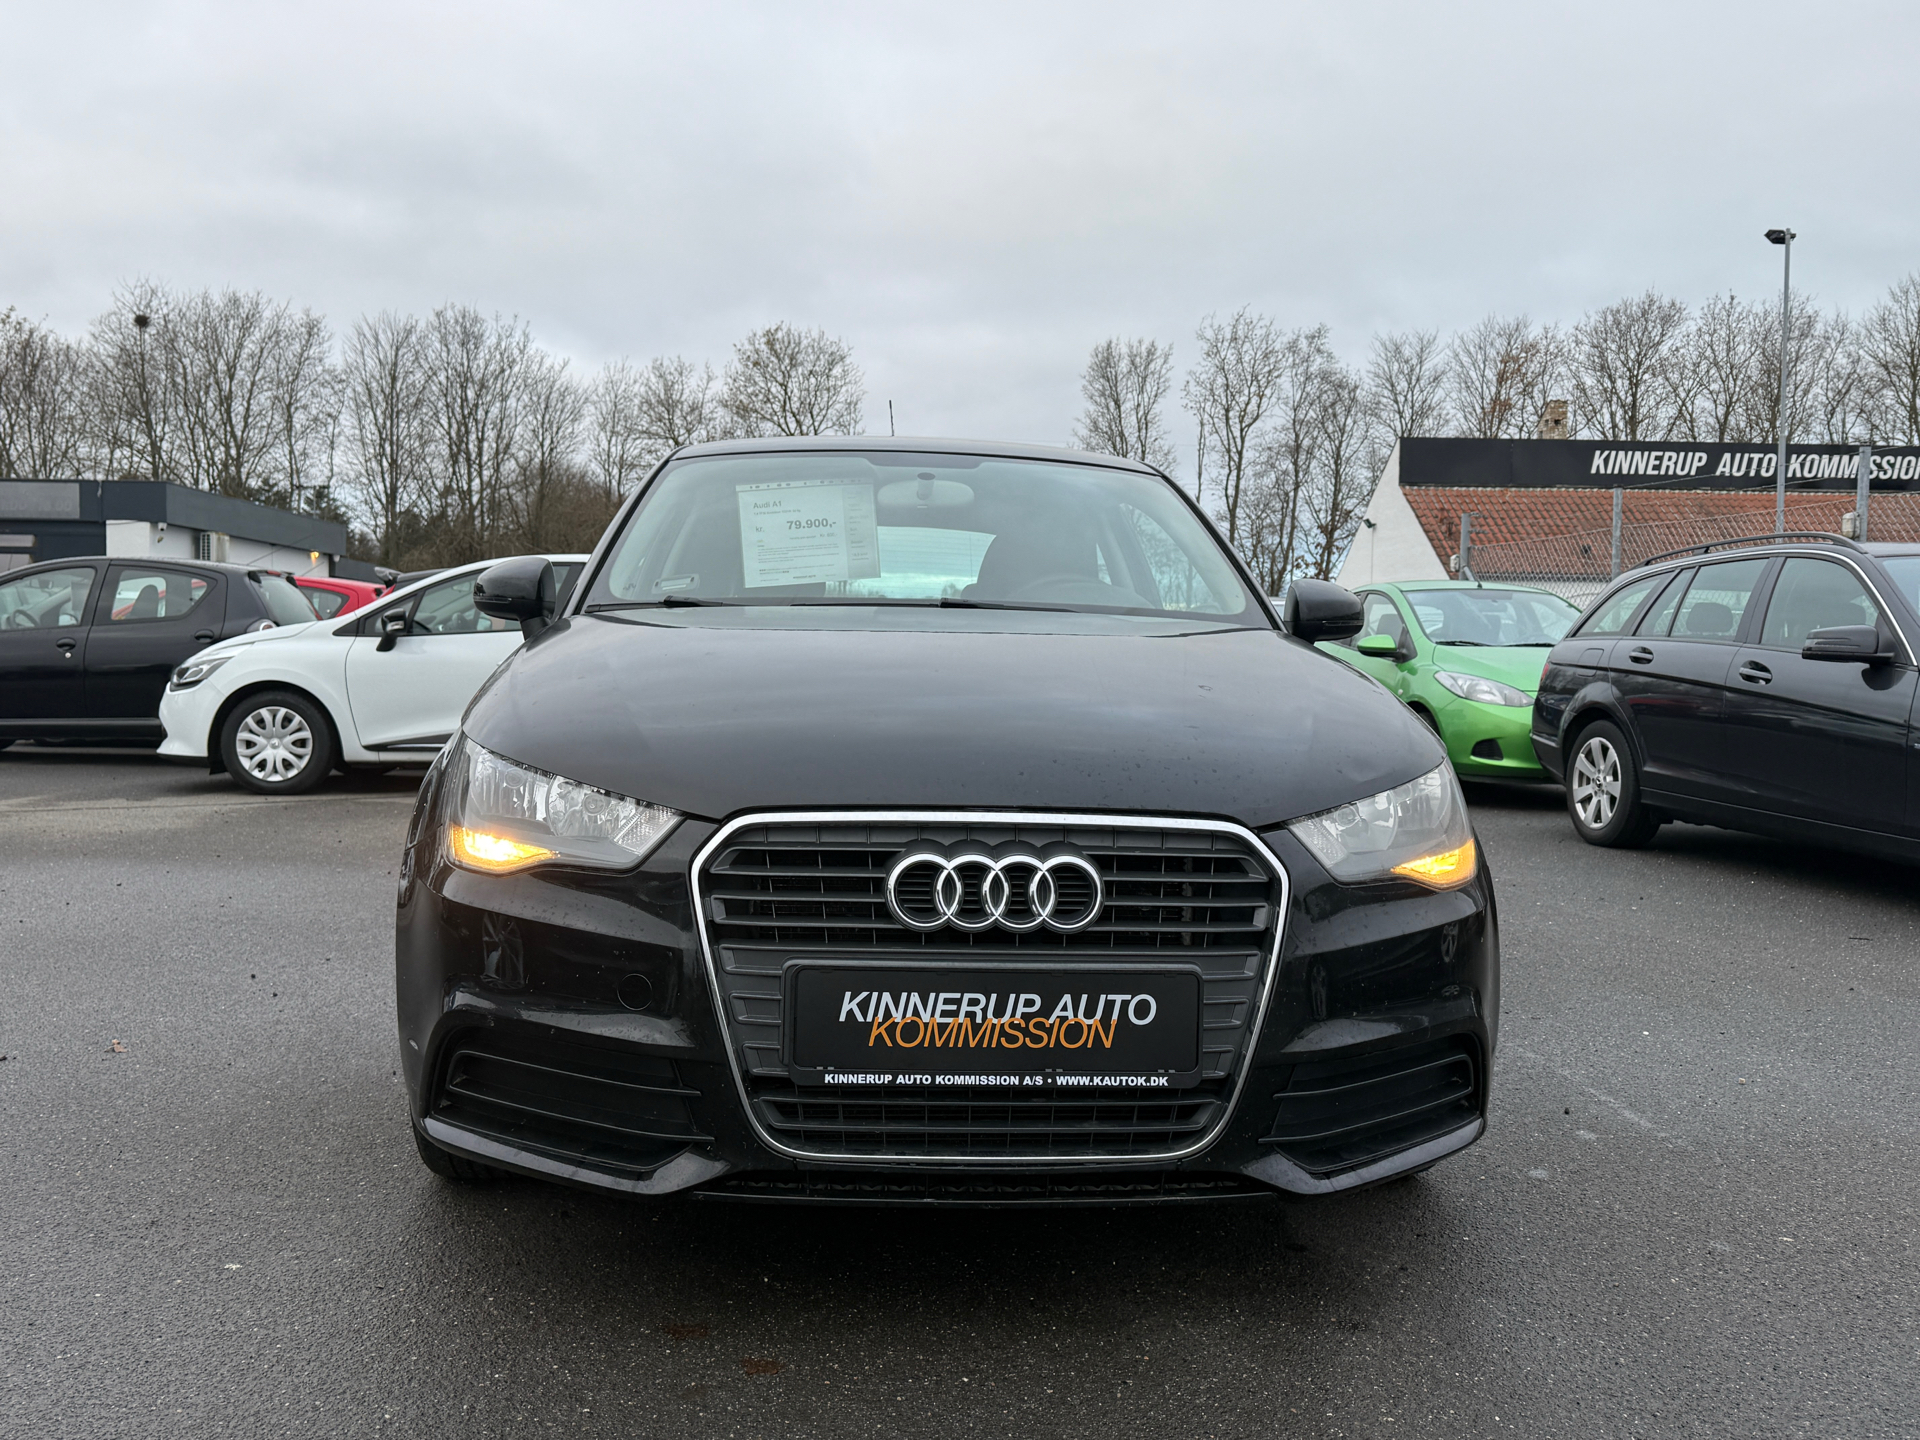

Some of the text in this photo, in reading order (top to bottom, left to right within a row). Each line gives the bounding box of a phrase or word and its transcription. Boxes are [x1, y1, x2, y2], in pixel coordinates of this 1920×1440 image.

[1590, 449, 1920, 481] KINNERUP AUTO KOMMSSIO
[753, 500, 782, 509] Audi A1
[786, 518, 837, 530] 79.900,-
[839, 991, 1157, 1026] KINNERUP AUTO
[868, 1016, 1117, 1049] KOMMISSION
[824, 1073, 1169, 1087] KINNERUP AUTO KOMMISSION A/S WWW.KAUTOK.DK
